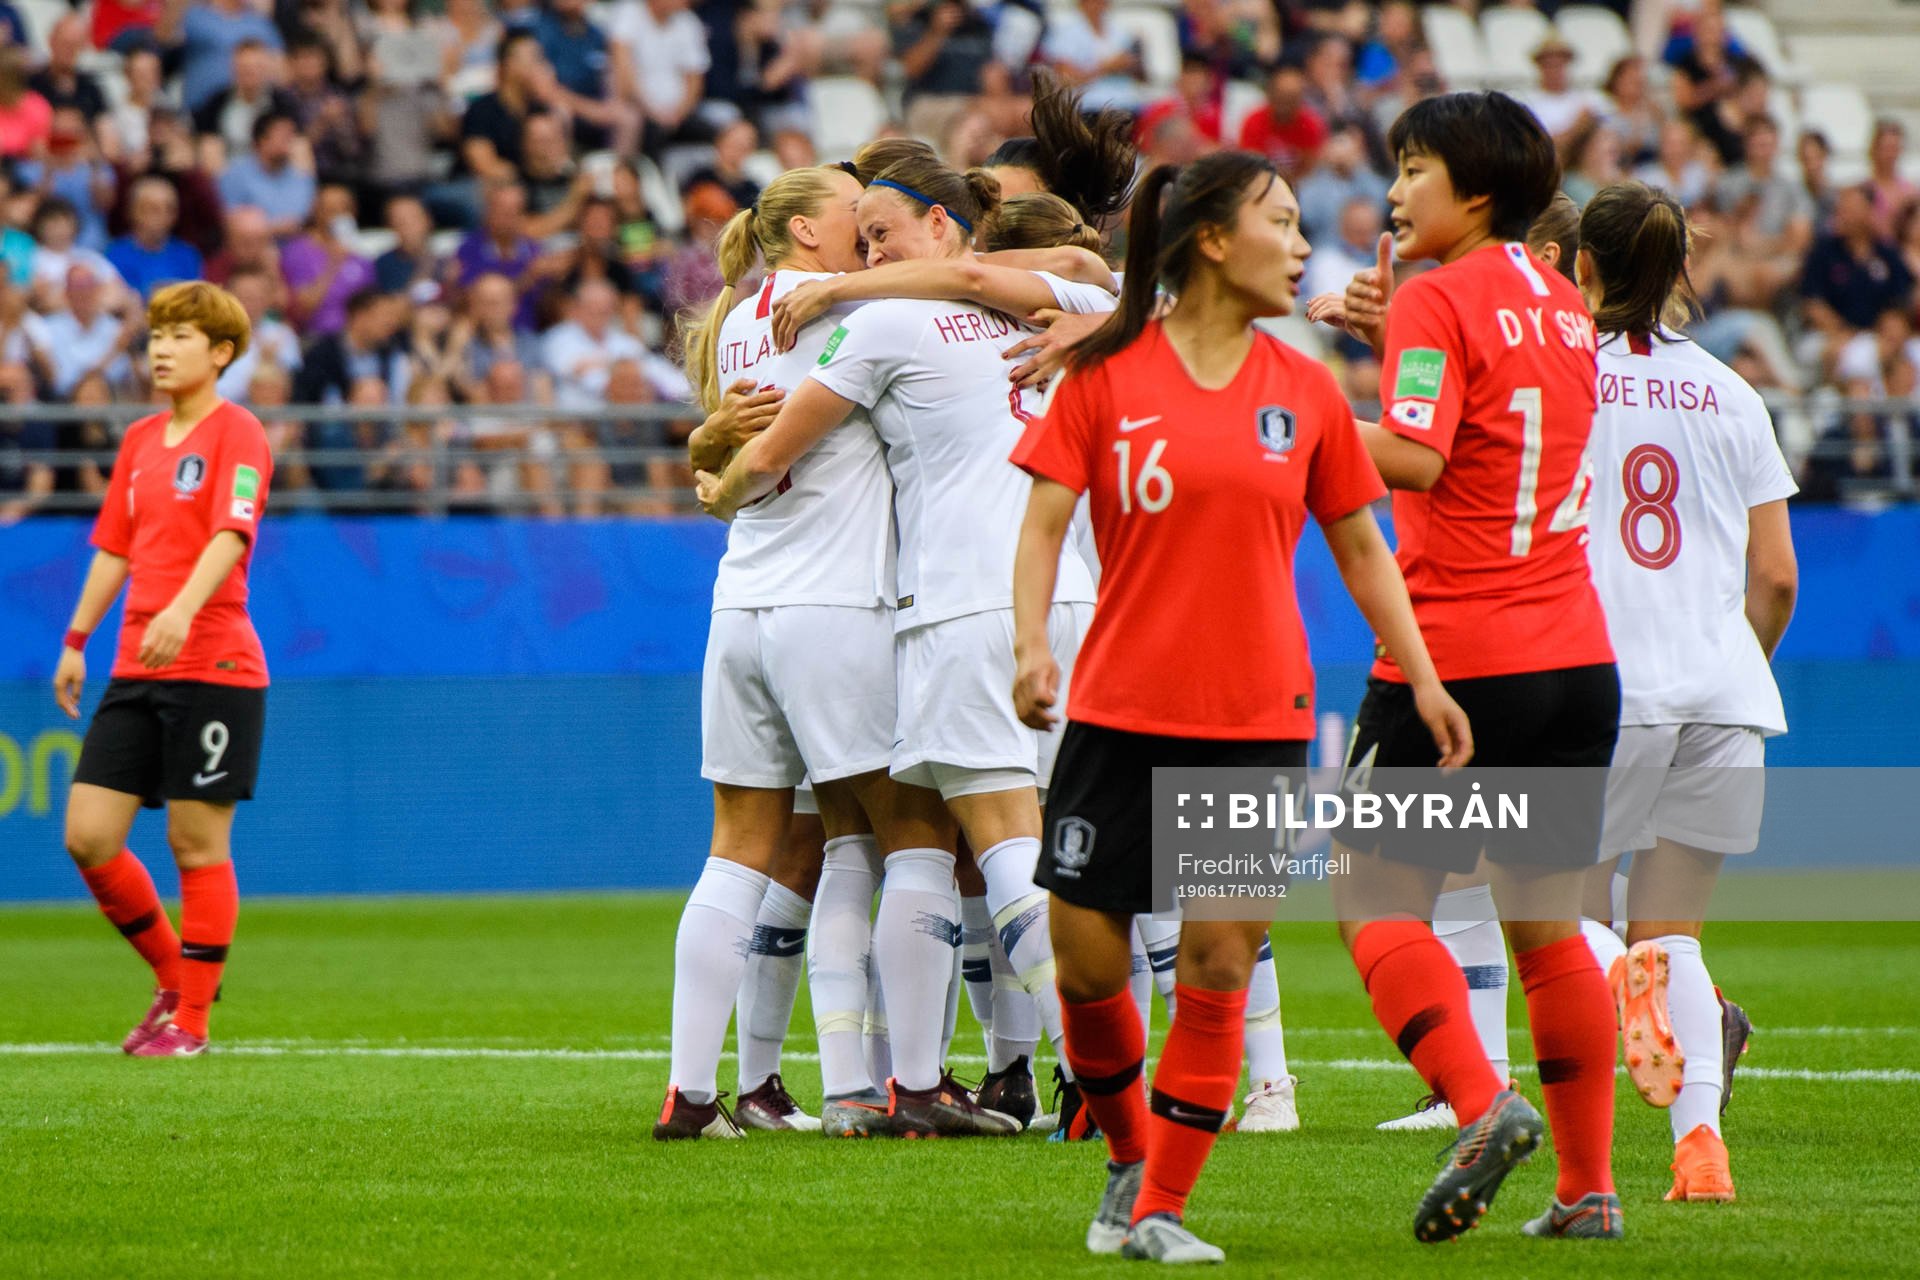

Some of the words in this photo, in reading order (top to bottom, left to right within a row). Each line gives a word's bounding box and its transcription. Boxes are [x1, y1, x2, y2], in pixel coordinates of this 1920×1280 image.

[1496, 308, 1524, 347] D
[1526, 307, 1546, 346] Y
[720, 334, 778, 374] UTLA
[1646, 378, 1720, 415] RISA
[1112, 439, 1173, 513] 16
[1620, 443, 1681, 570] 8
[200, 720, 230, 772] 9
